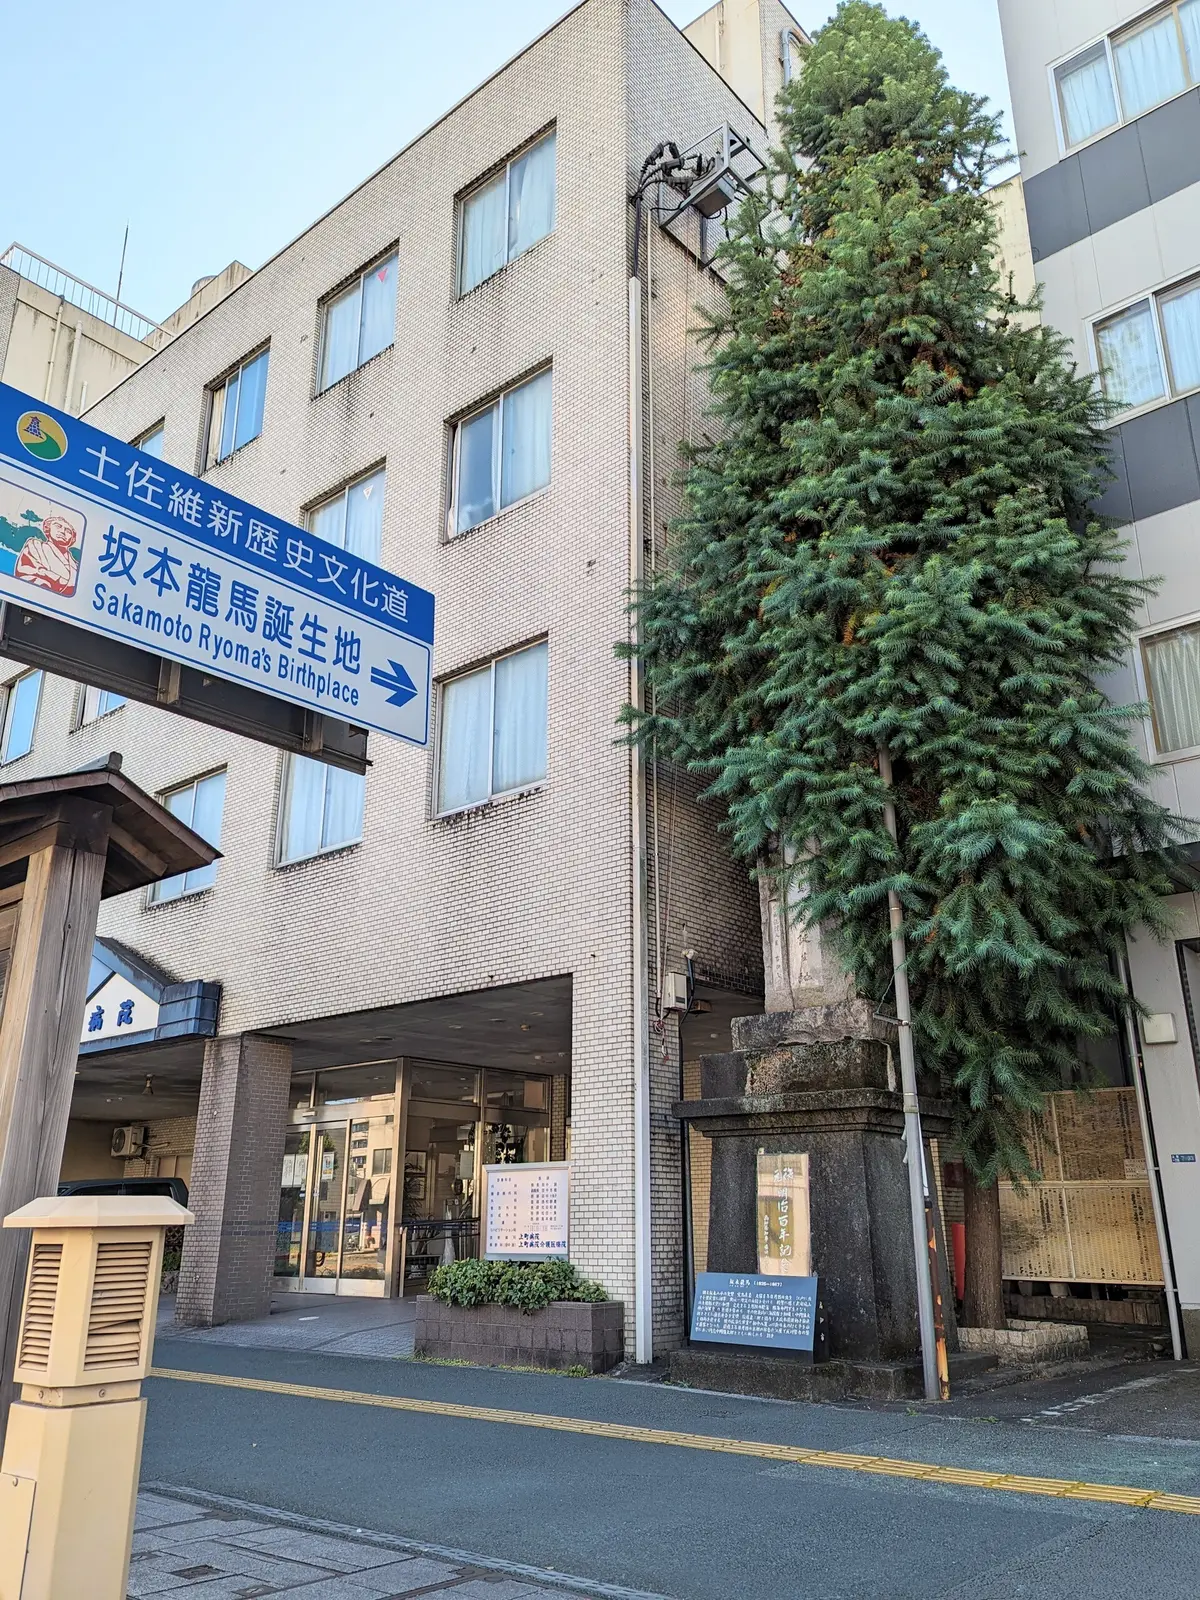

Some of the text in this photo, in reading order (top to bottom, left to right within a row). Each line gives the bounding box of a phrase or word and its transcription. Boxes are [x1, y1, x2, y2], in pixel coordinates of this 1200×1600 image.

[79, 446, 409, 623] 土佐維新歴史文化道
[98, 524, 362, 674] 坂本龍馬誕生地
[92, 583, 360, 706] Sakamoto Ryoma's Birthplace
